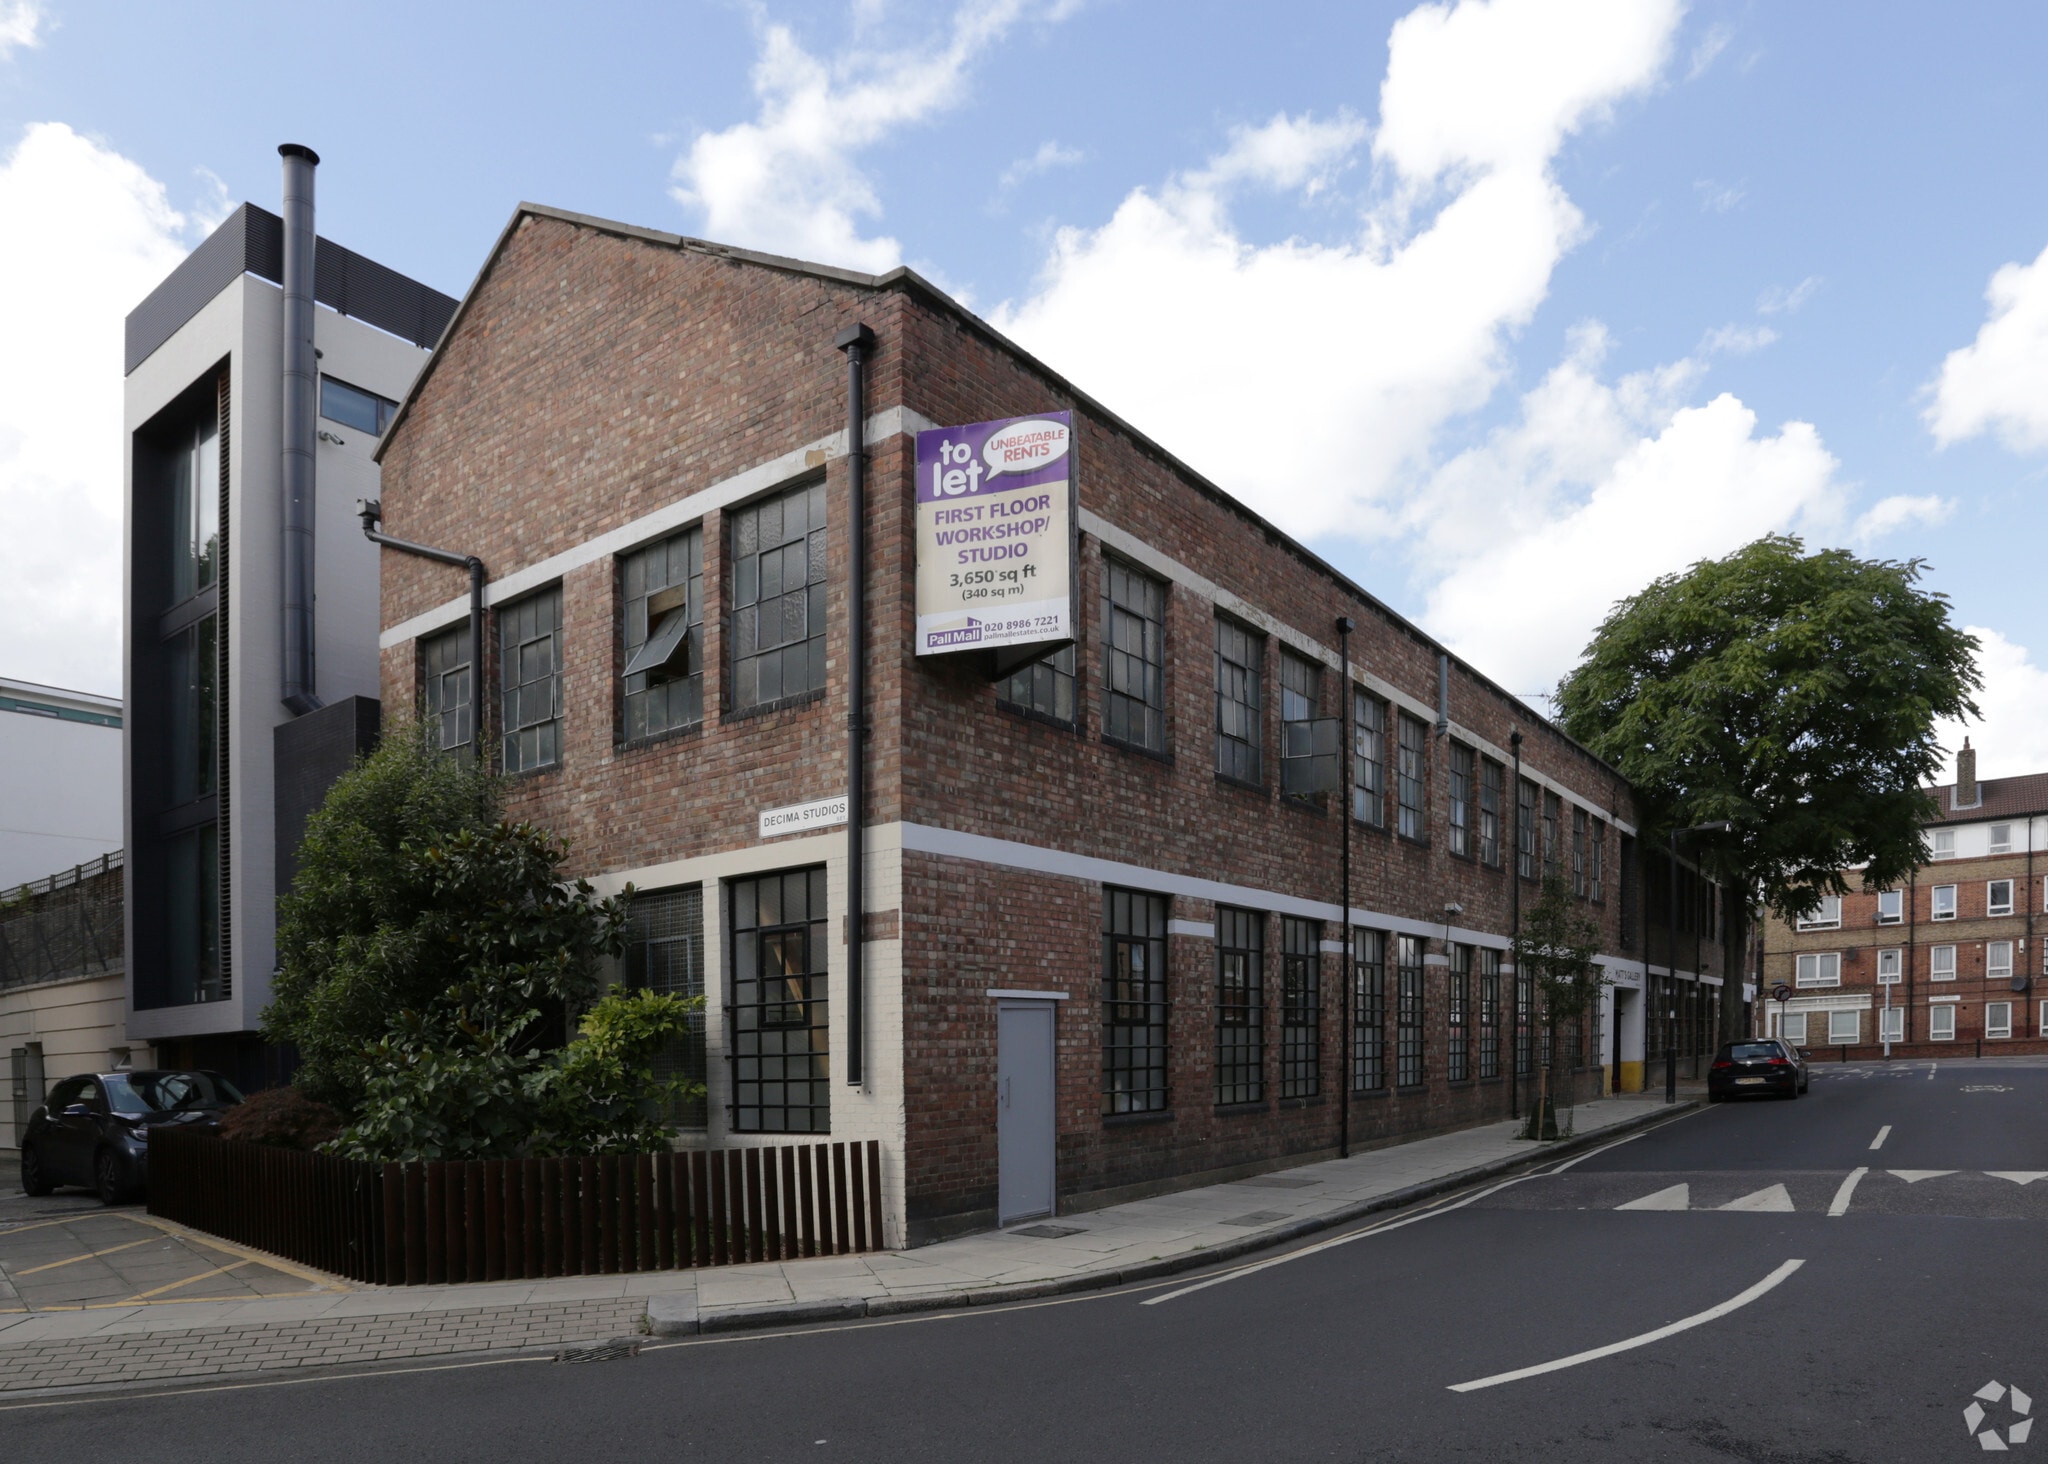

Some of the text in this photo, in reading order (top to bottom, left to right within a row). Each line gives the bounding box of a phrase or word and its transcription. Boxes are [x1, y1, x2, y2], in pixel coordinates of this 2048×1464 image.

[990, 429, 1065, 451] UNBEATABLE
[939, 439, 972, 466] to
[1003, 443, 1051, 463] RENTS
[933, 459, 983, 497] let
[934, 494, 1051, 526] FIRST FLOOR
[935, 515, 1051, 546] WORKSHOP/
[957, 542, 1028, 565] STUDIO
[949, 564, 1037, 588] 3,650 sq ft
[961, 583, 1025, 601] (340 sq m)
[983, 625, 1060, 641] pallmallestates.co.uk
[984, 615, 1059, 632] 020 8986 7221
[929, 629, 980, 646] Pall Mall
[763, 802, 846, 827] DECIMA STUDIOS
